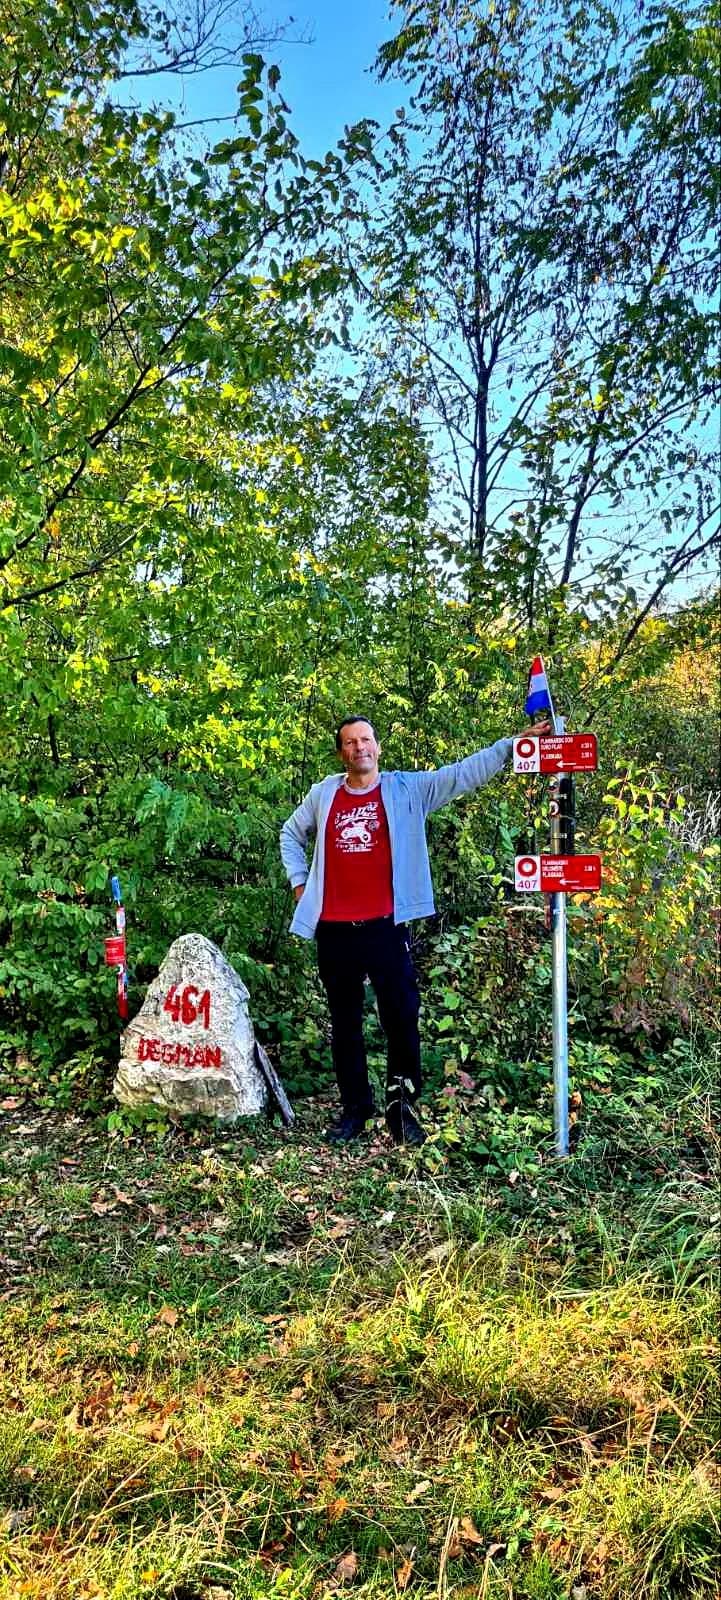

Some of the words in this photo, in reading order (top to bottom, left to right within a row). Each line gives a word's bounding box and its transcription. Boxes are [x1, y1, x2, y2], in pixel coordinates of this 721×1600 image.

[516, 761, 536, 771] 407
[517, 880, 537, 889] 407
[163, 985, 211, 1030] 461
[137, 1037, 221, 1068] DEGMAN
